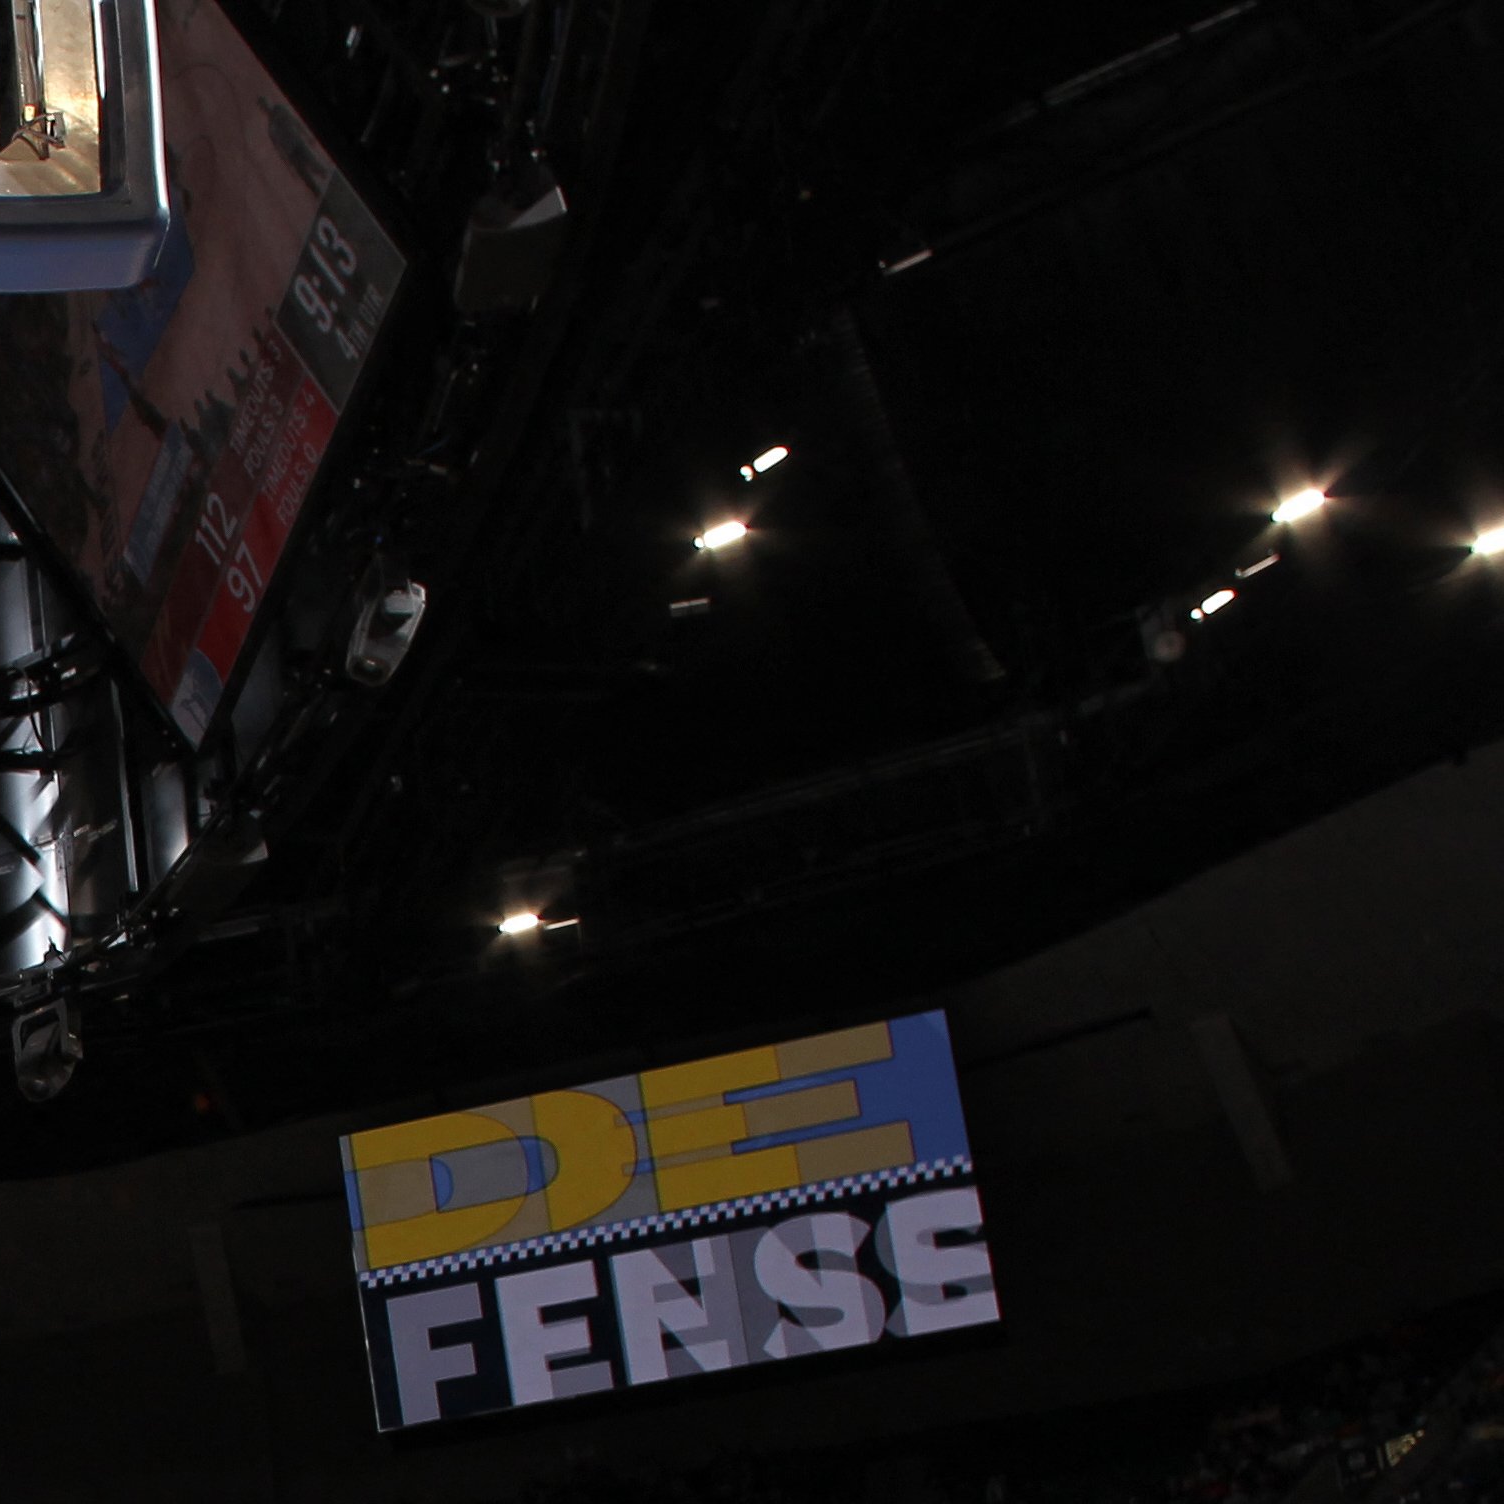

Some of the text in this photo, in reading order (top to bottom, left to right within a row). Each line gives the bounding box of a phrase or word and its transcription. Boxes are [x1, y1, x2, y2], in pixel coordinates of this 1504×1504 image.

[294, 215, 357, 334] 9:13
[194, 491, 239, 567] 112
[225, 540, 264, 614] 97
